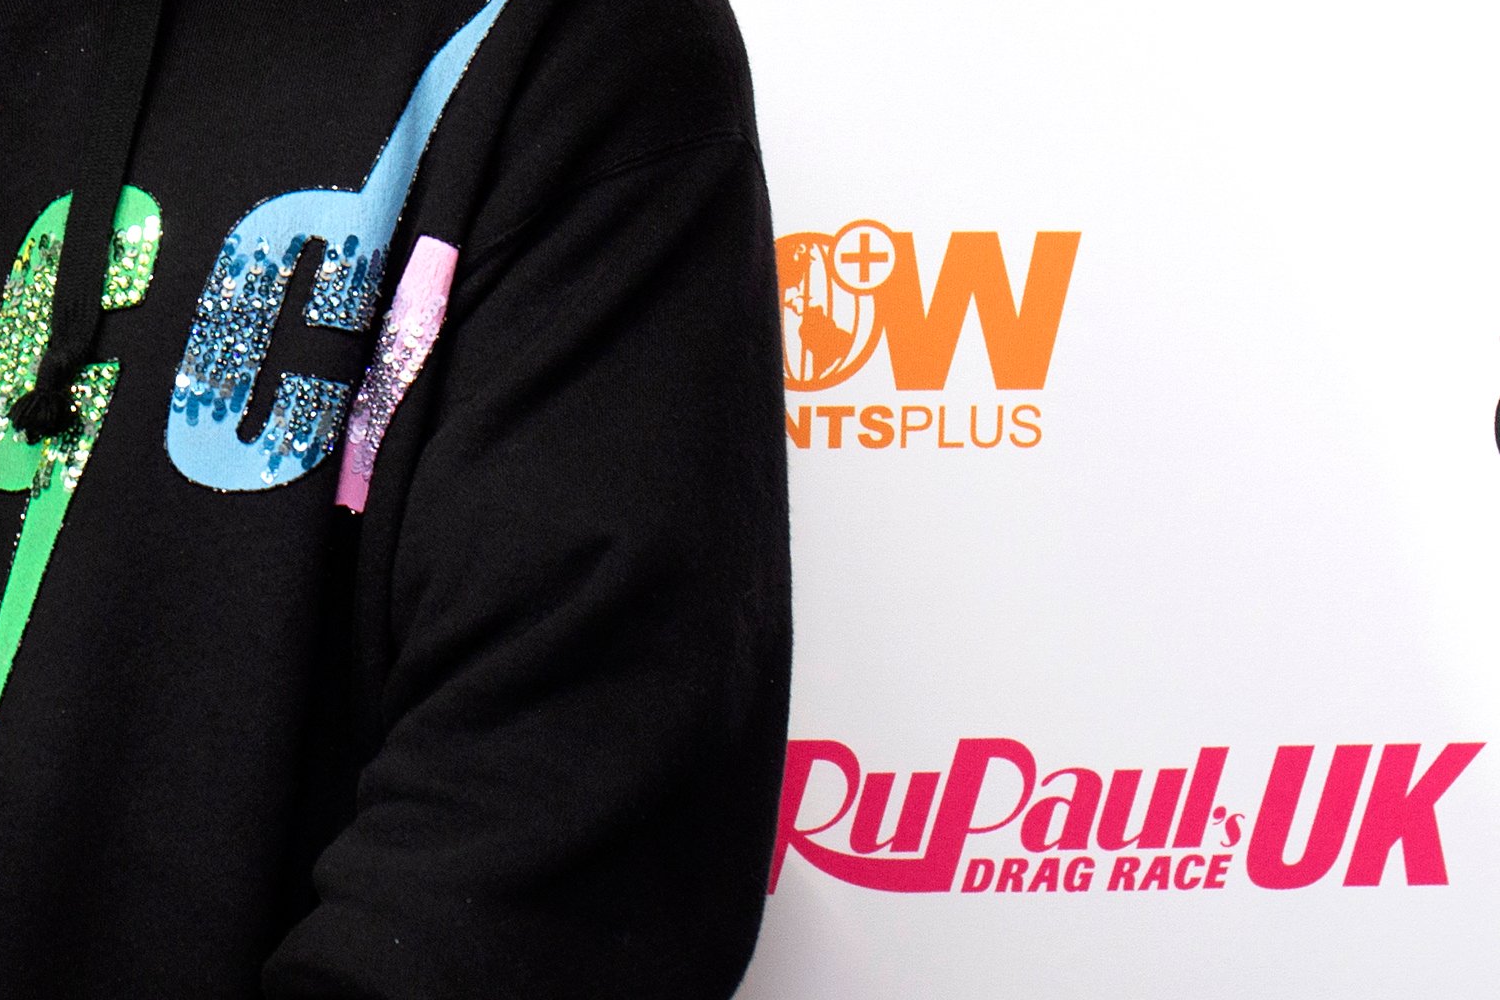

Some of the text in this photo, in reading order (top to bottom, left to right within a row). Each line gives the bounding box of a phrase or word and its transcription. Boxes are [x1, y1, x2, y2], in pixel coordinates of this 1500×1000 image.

[766, 737, 1487, 895] RuPaul's UK
[960, 853, 1234, 893] DRAG RACE
